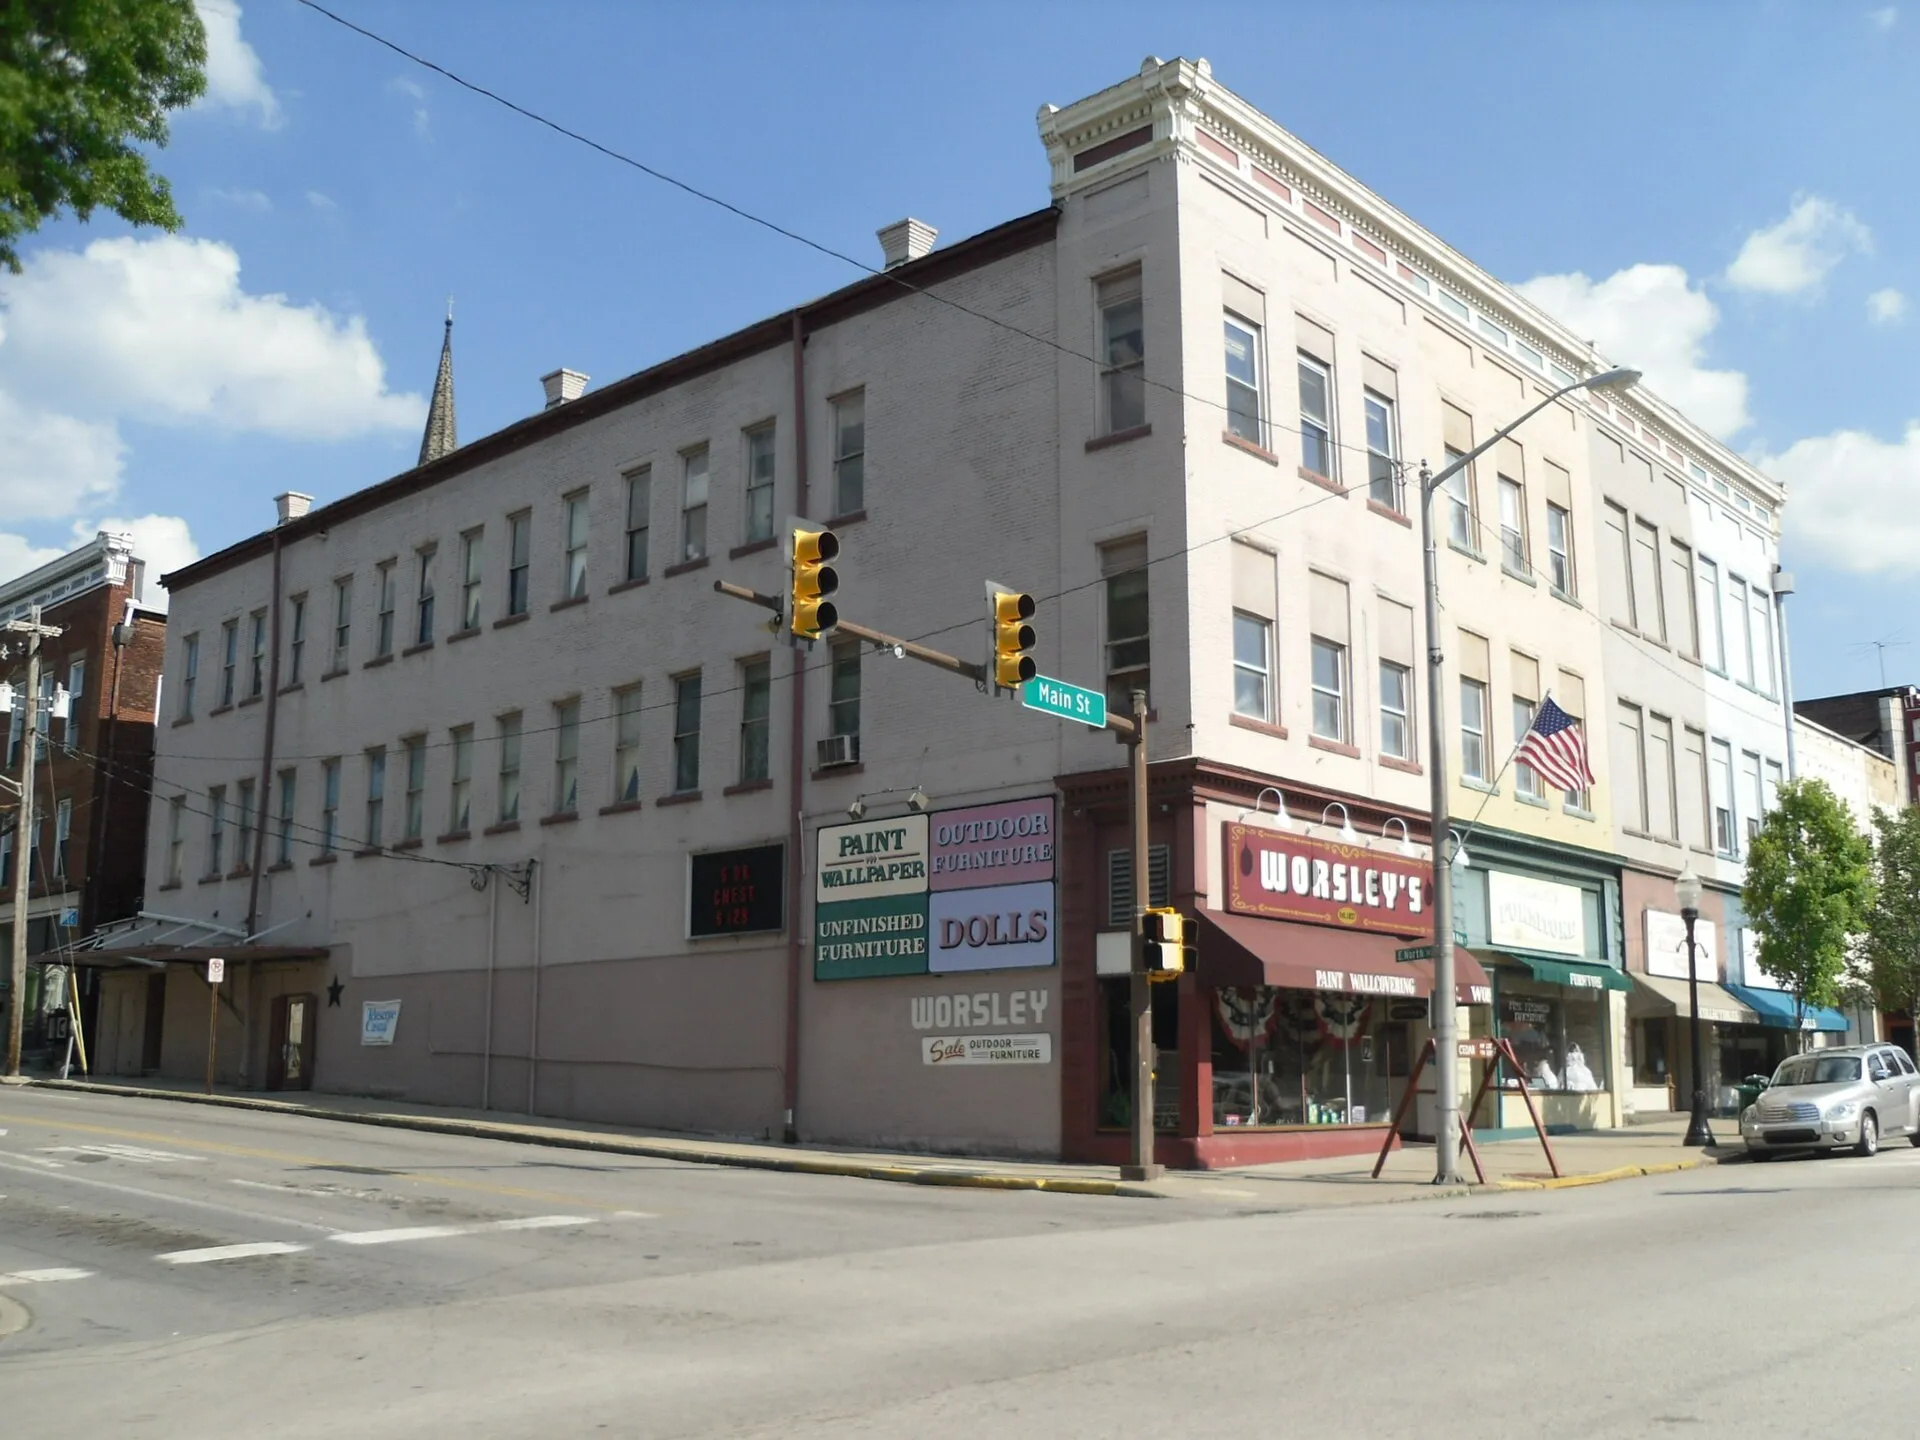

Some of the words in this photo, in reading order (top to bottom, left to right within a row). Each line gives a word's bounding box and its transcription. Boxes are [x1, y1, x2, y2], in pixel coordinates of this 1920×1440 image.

[1039, 681, 1072, 710] Main
[1076, 693, 1091, 716] St
[838, 828, 907, 858] PAINT
[937, 812, 1050, 847] OUTDOOR
[932, 843, 1053, 875] FURNITURE
[820, 860, 926, 889] WALLPAPER
[1259, 849, 1424, 914] WORSLEY'S
[819, 912, 925, 938] UNFINISHED
[938, 908, 1049, 950] DOLLS
[818, 937, 926, 962] FURNITURE
[1315, 969, 1344, 989] PAINT
[1349, 972, 1416, 996] WALLCOVERING
[911, 989, 1048, 1030] WORSLEY
[930, 1039, 966, 1063] Sale
[969, 1039, 1012, 1049] OUTDOOR
[990, 1049, 1041, 1059] FURNITURE
